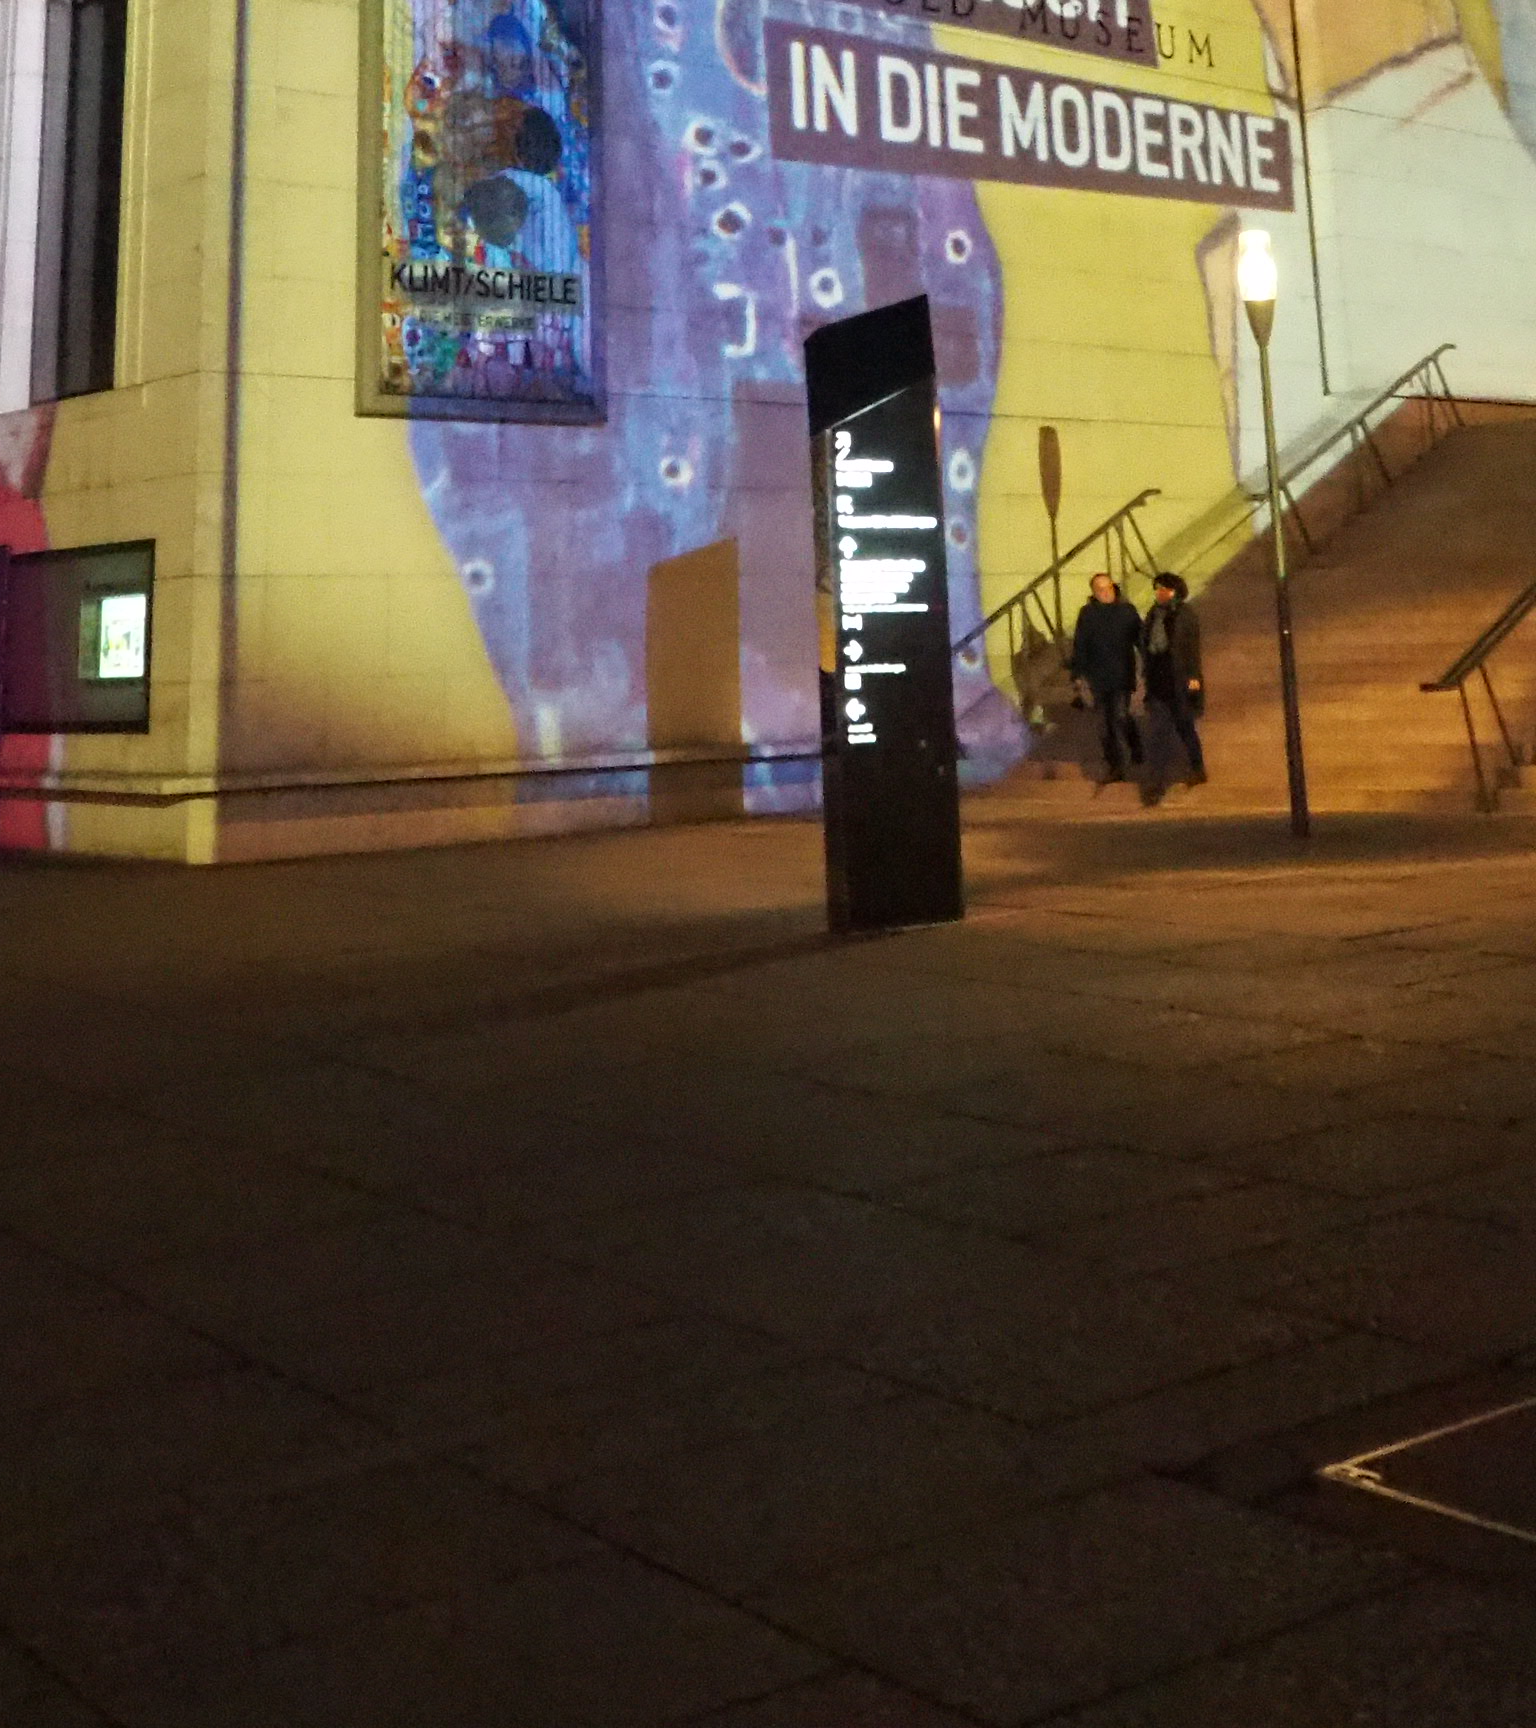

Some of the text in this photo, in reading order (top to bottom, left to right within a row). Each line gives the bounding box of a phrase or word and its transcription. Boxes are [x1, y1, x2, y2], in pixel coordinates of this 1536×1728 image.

[789, 41, 1281, 194] IN DIE MODERNE
